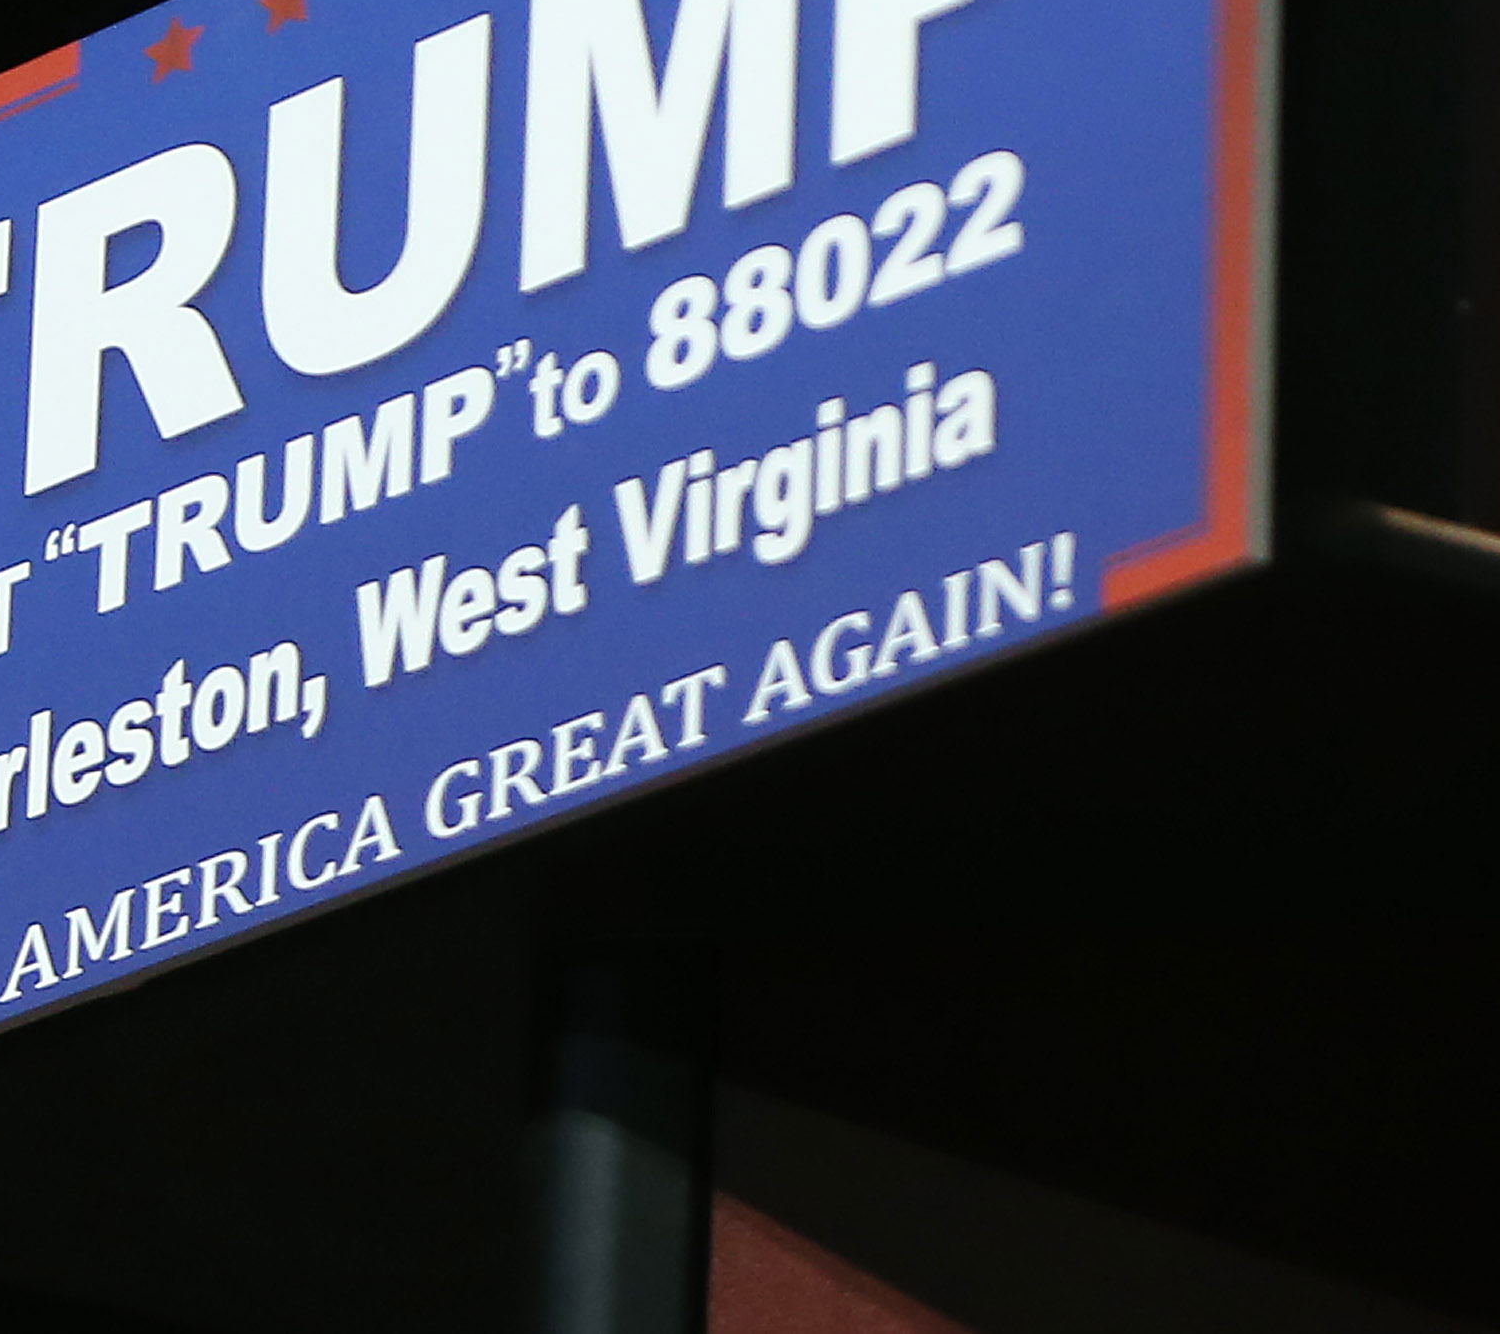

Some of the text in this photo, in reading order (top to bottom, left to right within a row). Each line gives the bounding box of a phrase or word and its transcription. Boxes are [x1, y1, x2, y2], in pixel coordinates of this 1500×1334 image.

[528, 351, 622, 441] to
[645, 149, 1026, 392] 88022
[355, 502, 591, 689] West
[612, 360, 997, 586] Virginia
[424, 664, 727, 839] GREAT
[739, 530, 1077, 726] AGAIN!
